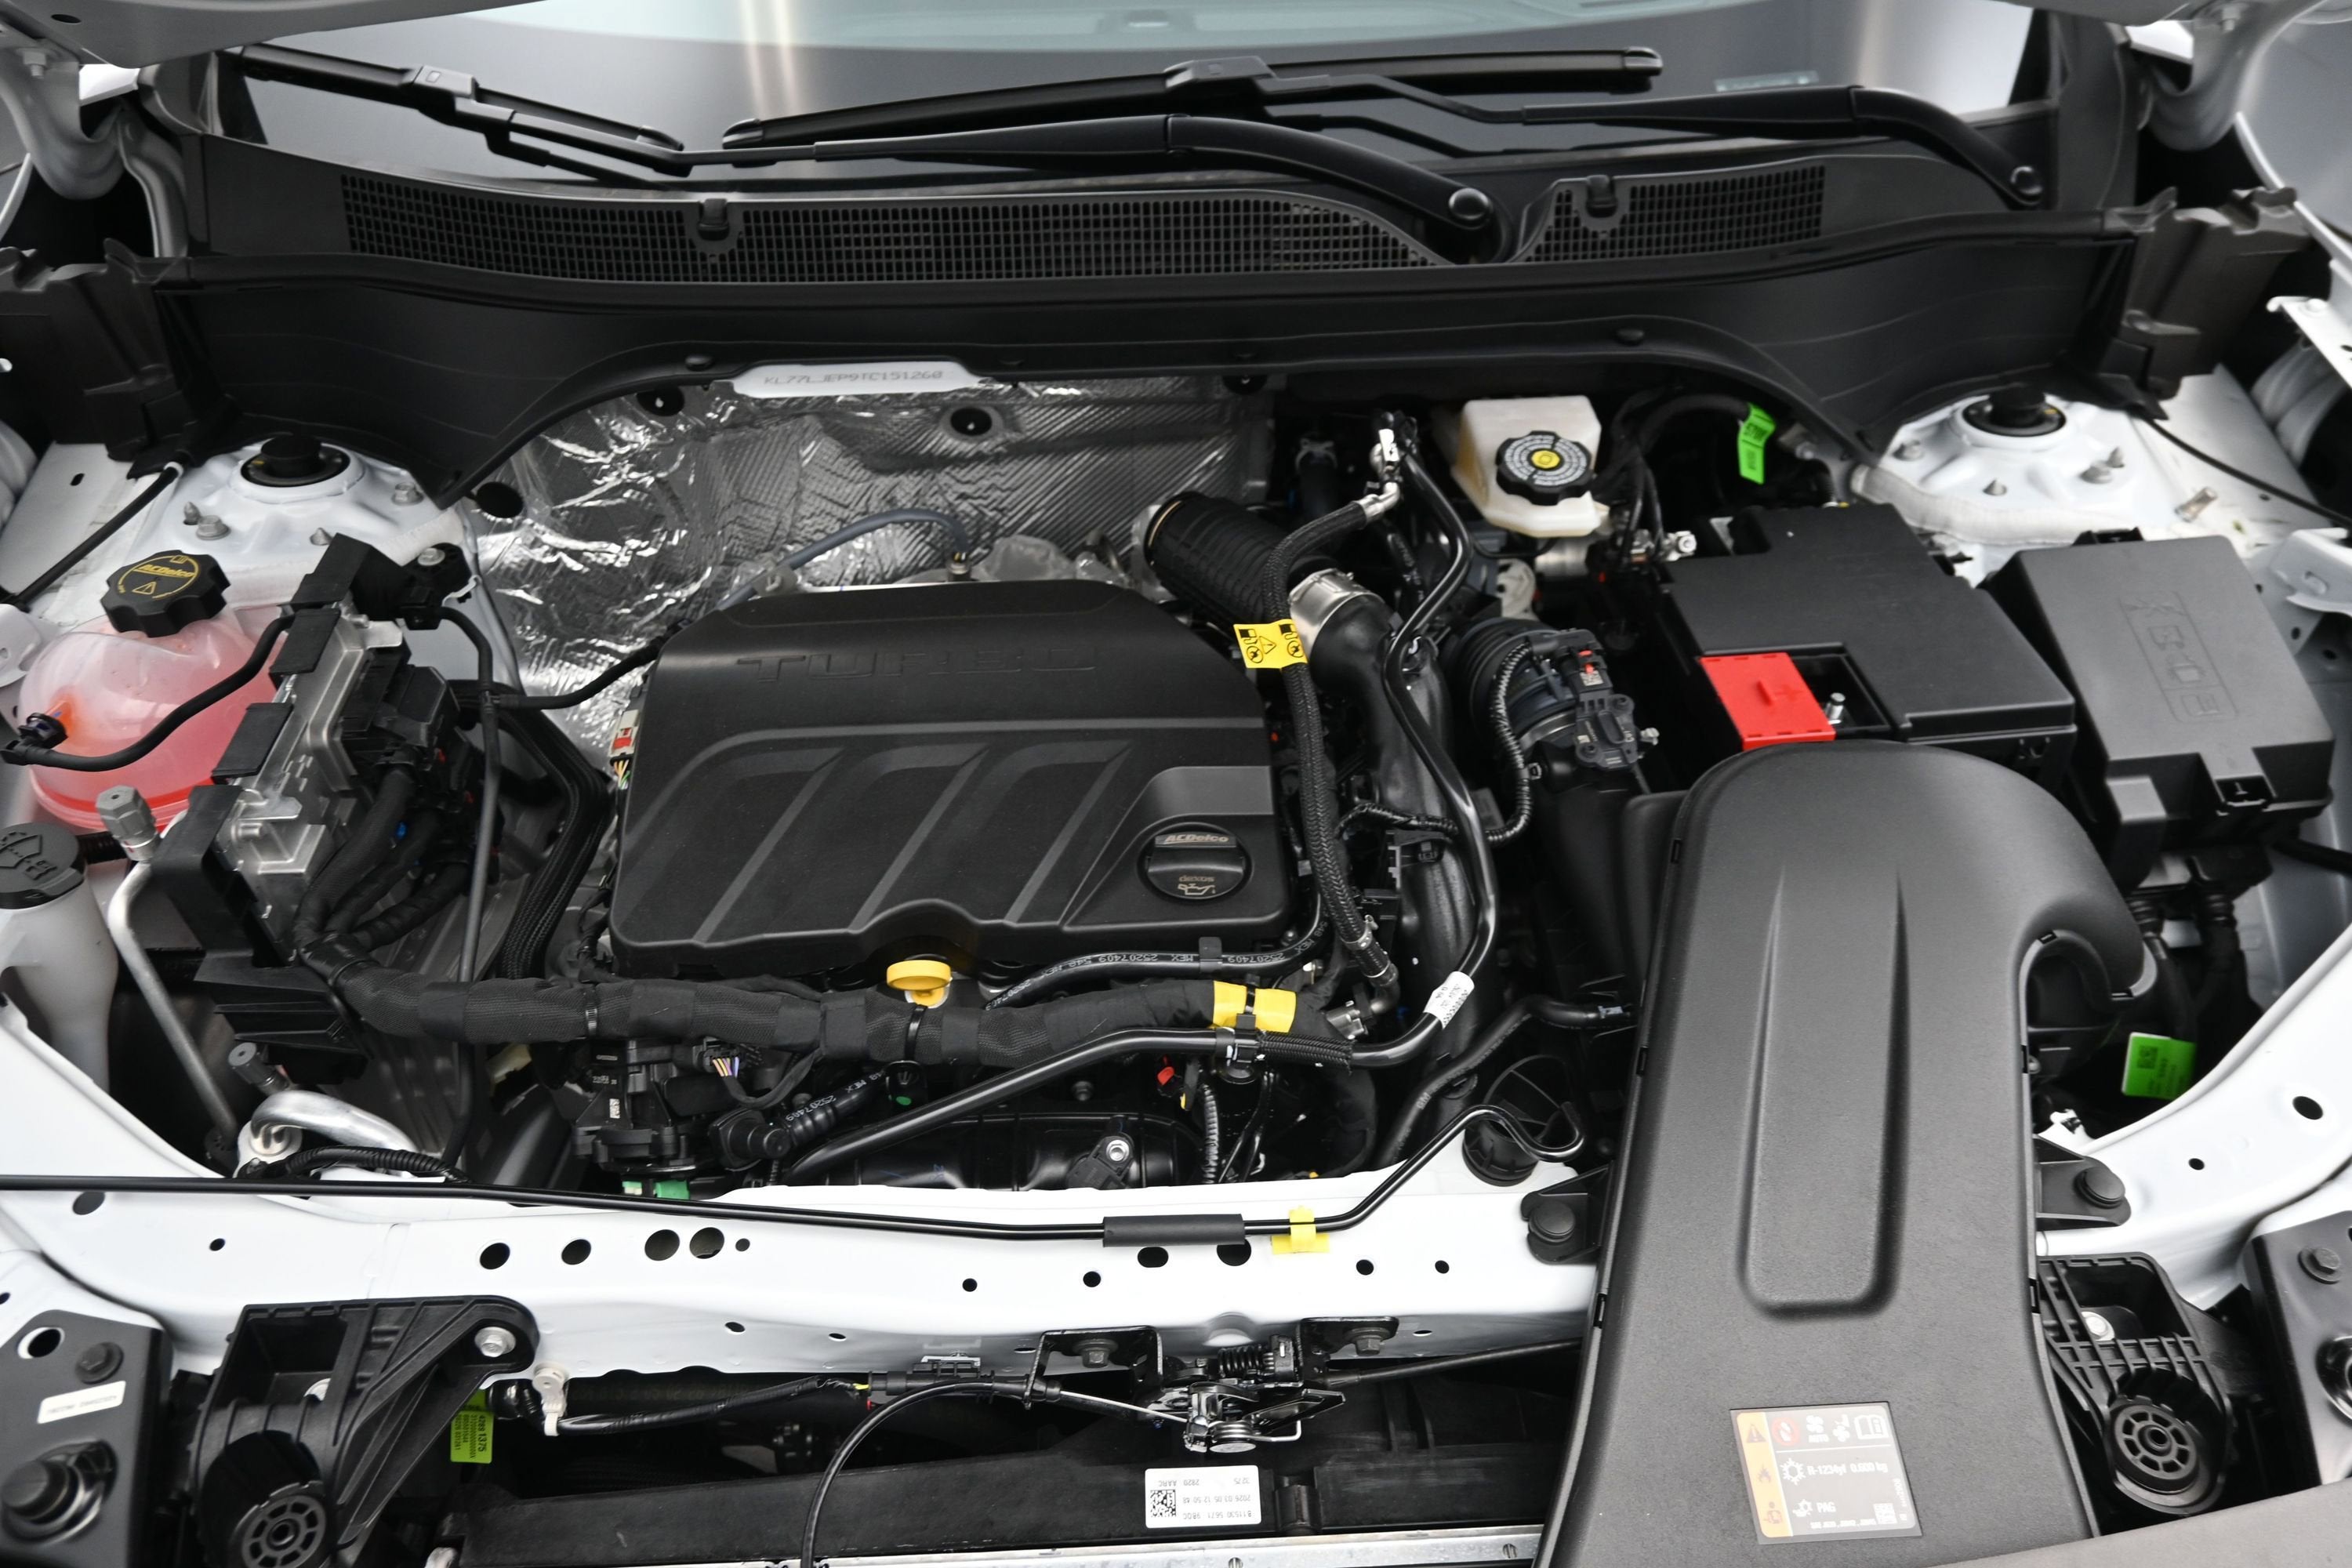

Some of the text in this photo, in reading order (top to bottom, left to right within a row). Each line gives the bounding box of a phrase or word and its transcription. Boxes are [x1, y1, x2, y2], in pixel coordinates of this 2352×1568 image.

[140, 564, 194, 577] ACDelco
[1165, 834, 1230, 844] ACDelco
[1099, 953, 1158, 963] 25207409
[1228, 953, 1285, 962] 25207409
[785, 1094, 837, 1122] 25207409
[1817, 1502, 1836, 1513] PAG
